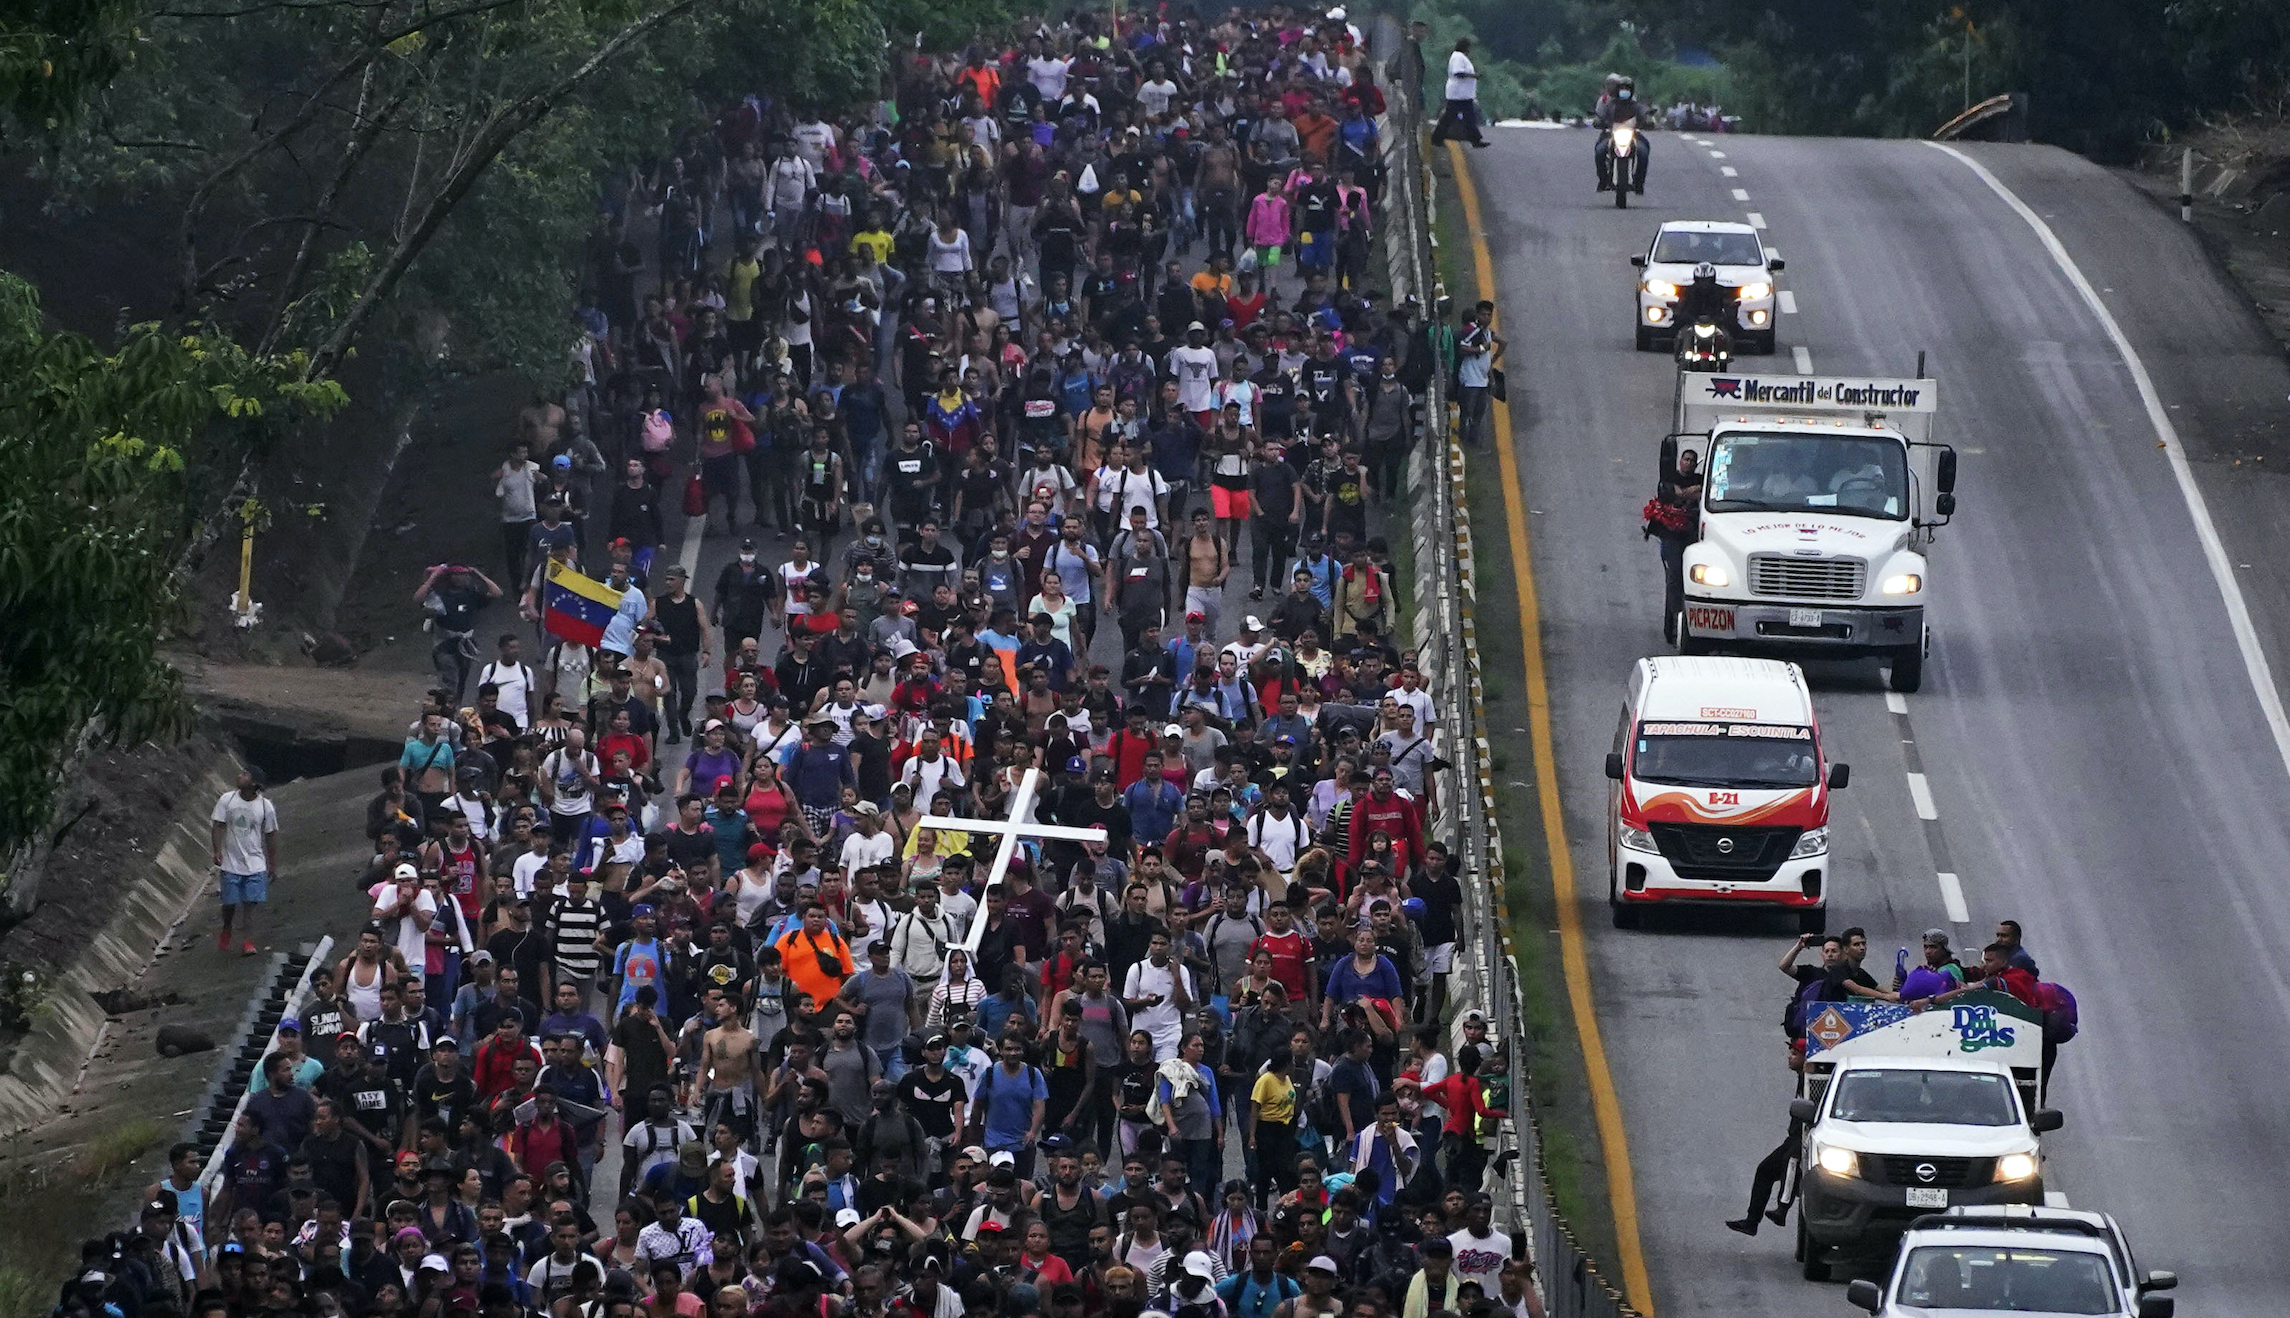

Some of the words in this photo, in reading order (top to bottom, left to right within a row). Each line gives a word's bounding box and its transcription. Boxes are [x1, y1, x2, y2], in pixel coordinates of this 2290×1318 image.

[1744, 379, 1815, 404] Mercantil
[1817, 386, 1832, 400] del
[1835, 383, 1920, 408] Constructor
[1688, 607, 1736, 631] PICAZON
[1709, 792, 1739, 805] E-21
